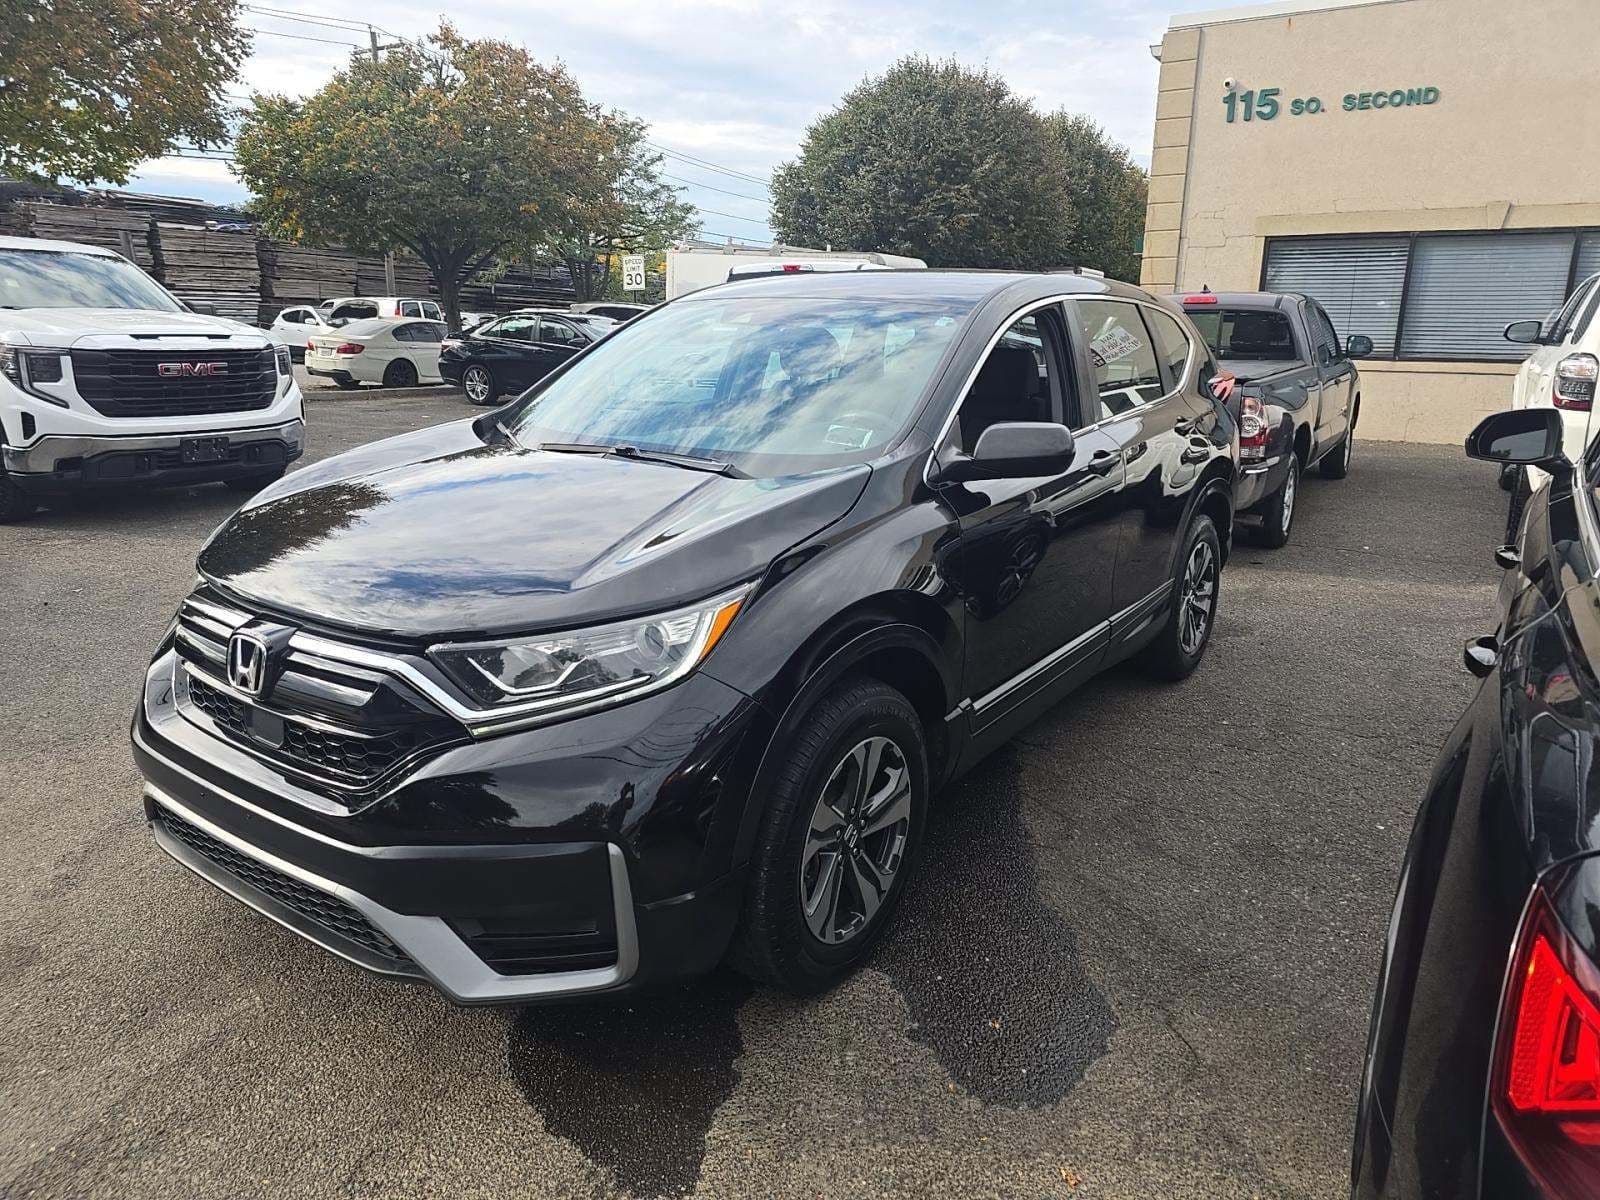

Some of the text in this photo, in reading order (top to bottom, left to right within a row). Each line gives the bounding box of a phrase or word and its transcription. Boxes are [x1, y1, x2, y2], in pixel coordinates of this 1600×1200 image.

[1222, 86, 1440, 123] 115 SO. SECOND
[626, 273, 642, 285] 30
[158, 362, 228, 377] GMC
